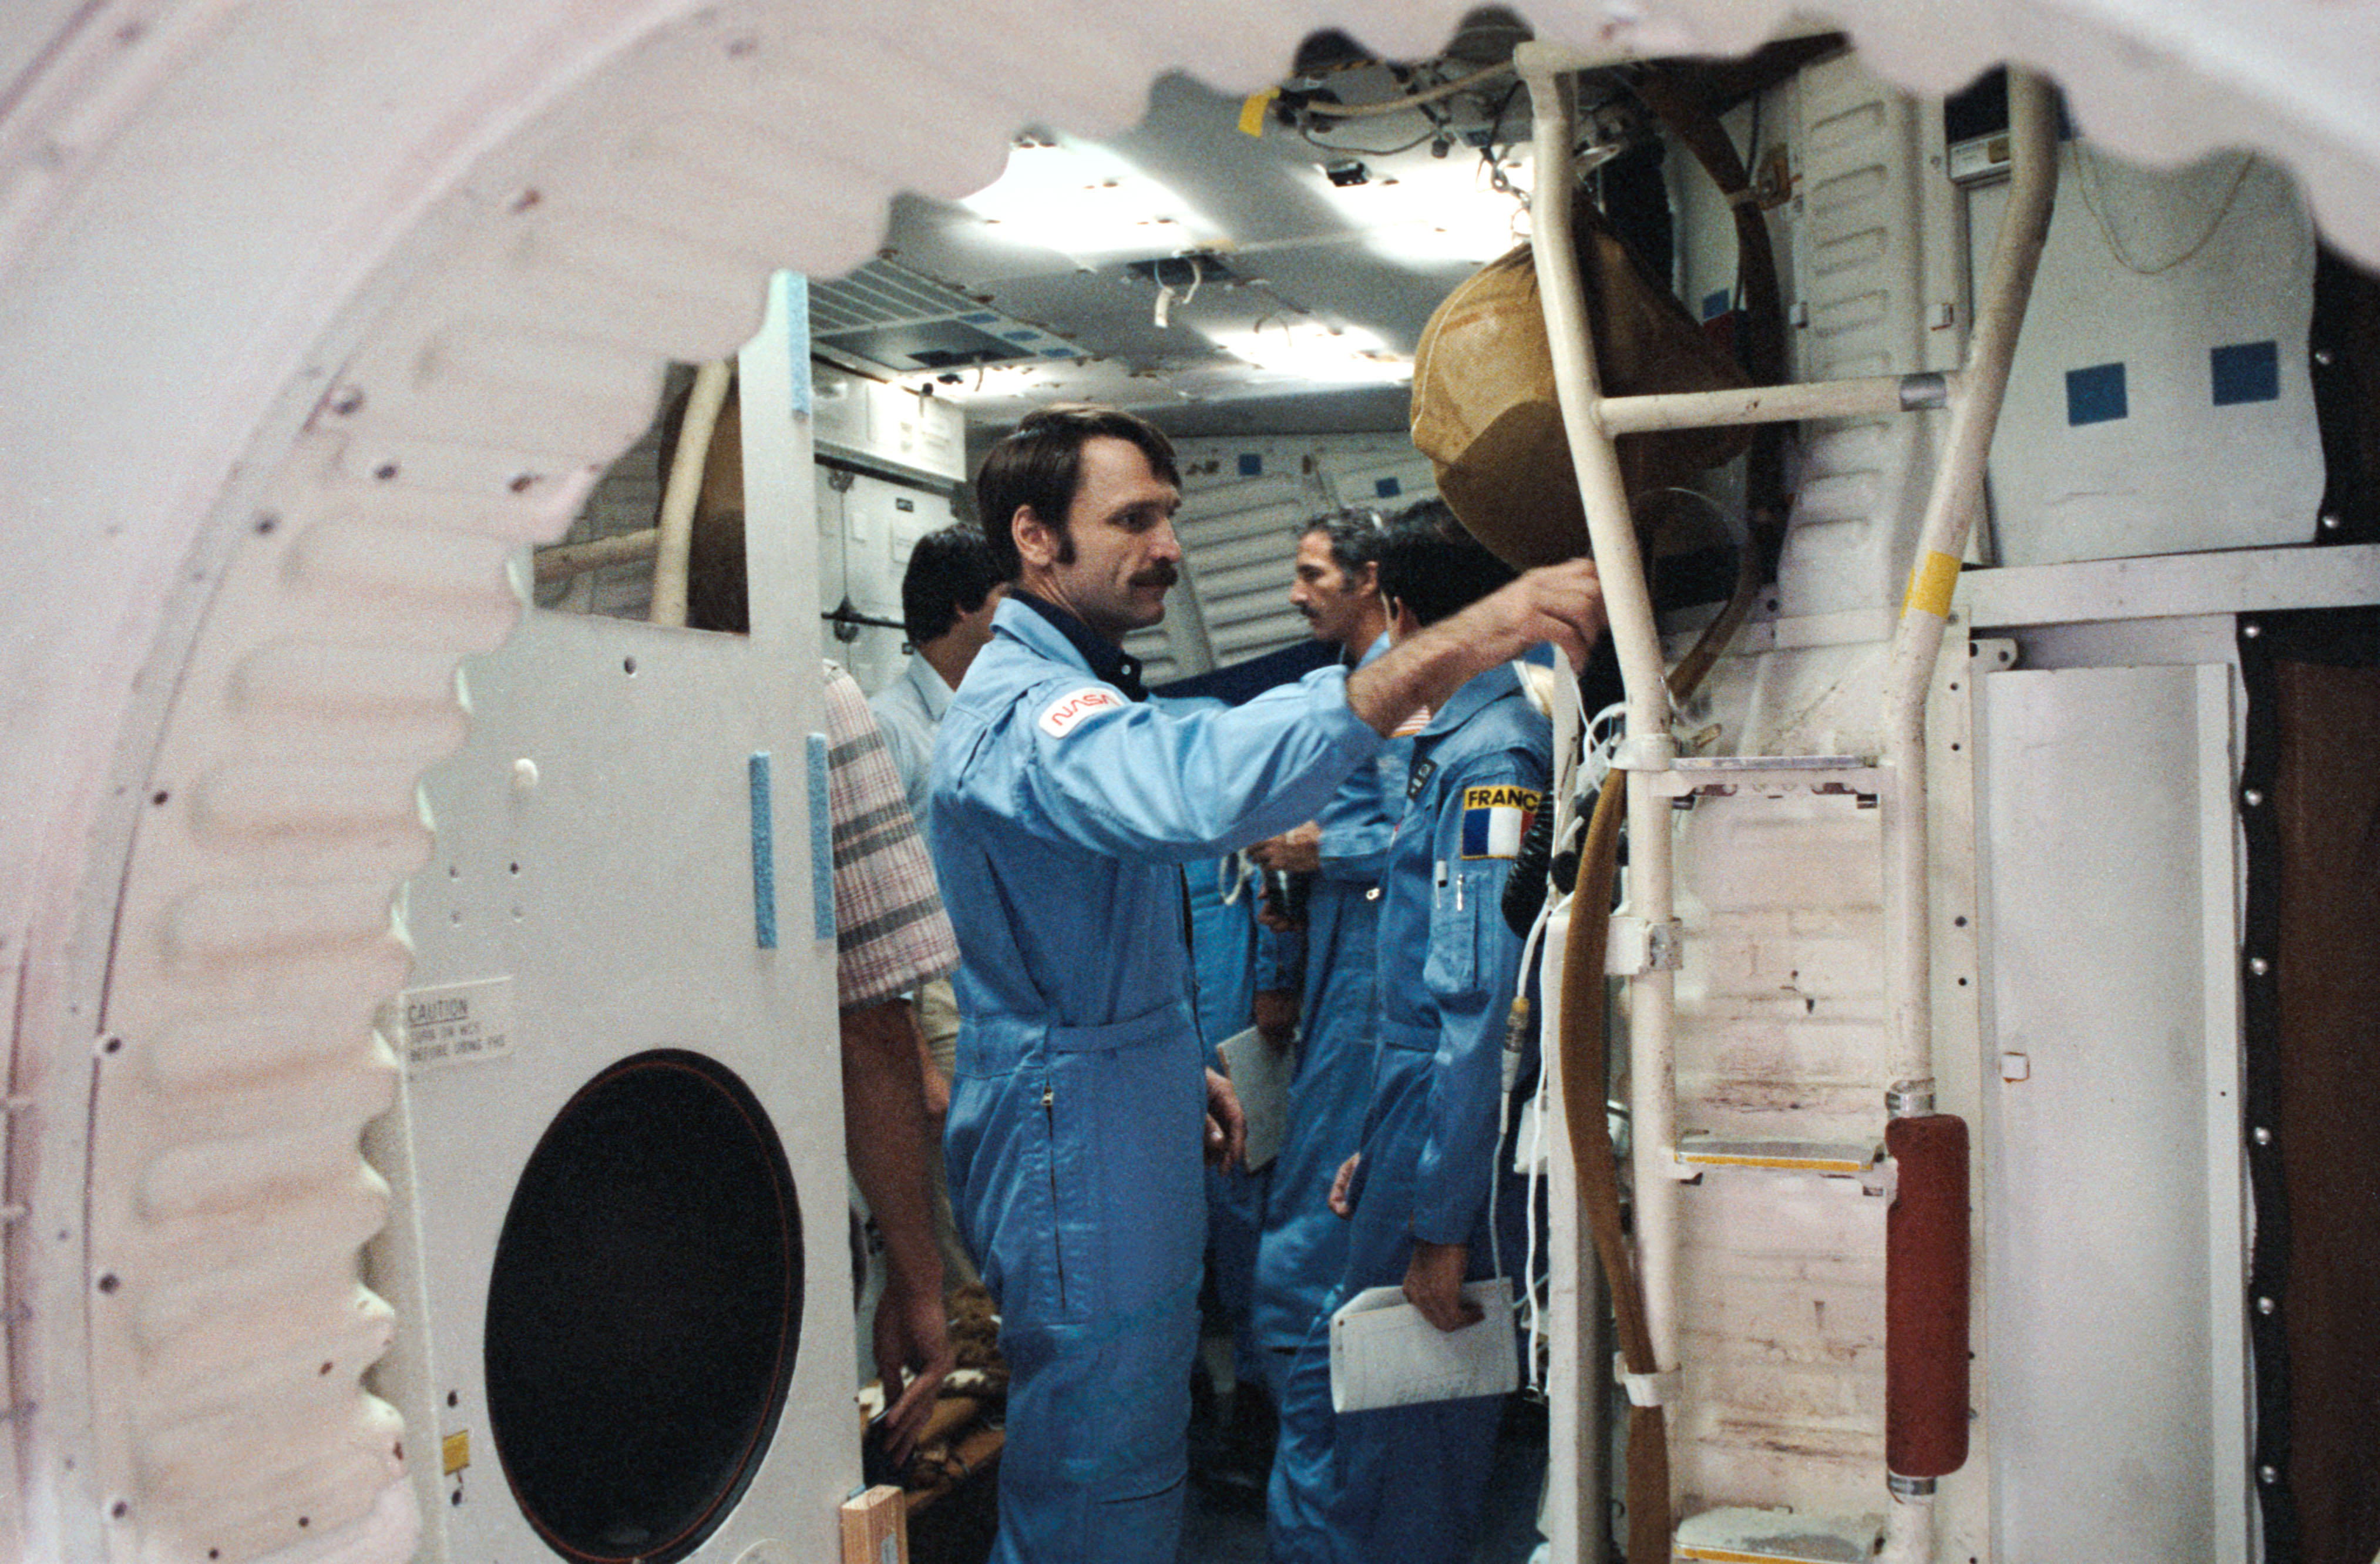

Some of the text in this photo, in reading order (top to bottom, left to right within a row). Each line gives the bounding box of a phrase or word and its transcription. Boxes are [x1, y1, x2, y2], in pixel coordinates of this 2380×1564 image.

[1051, 694, 1122, 726] NASA
[1468, 789, 1539, 811] FRANC
[408, 998, 468, 1023] CAUTION
